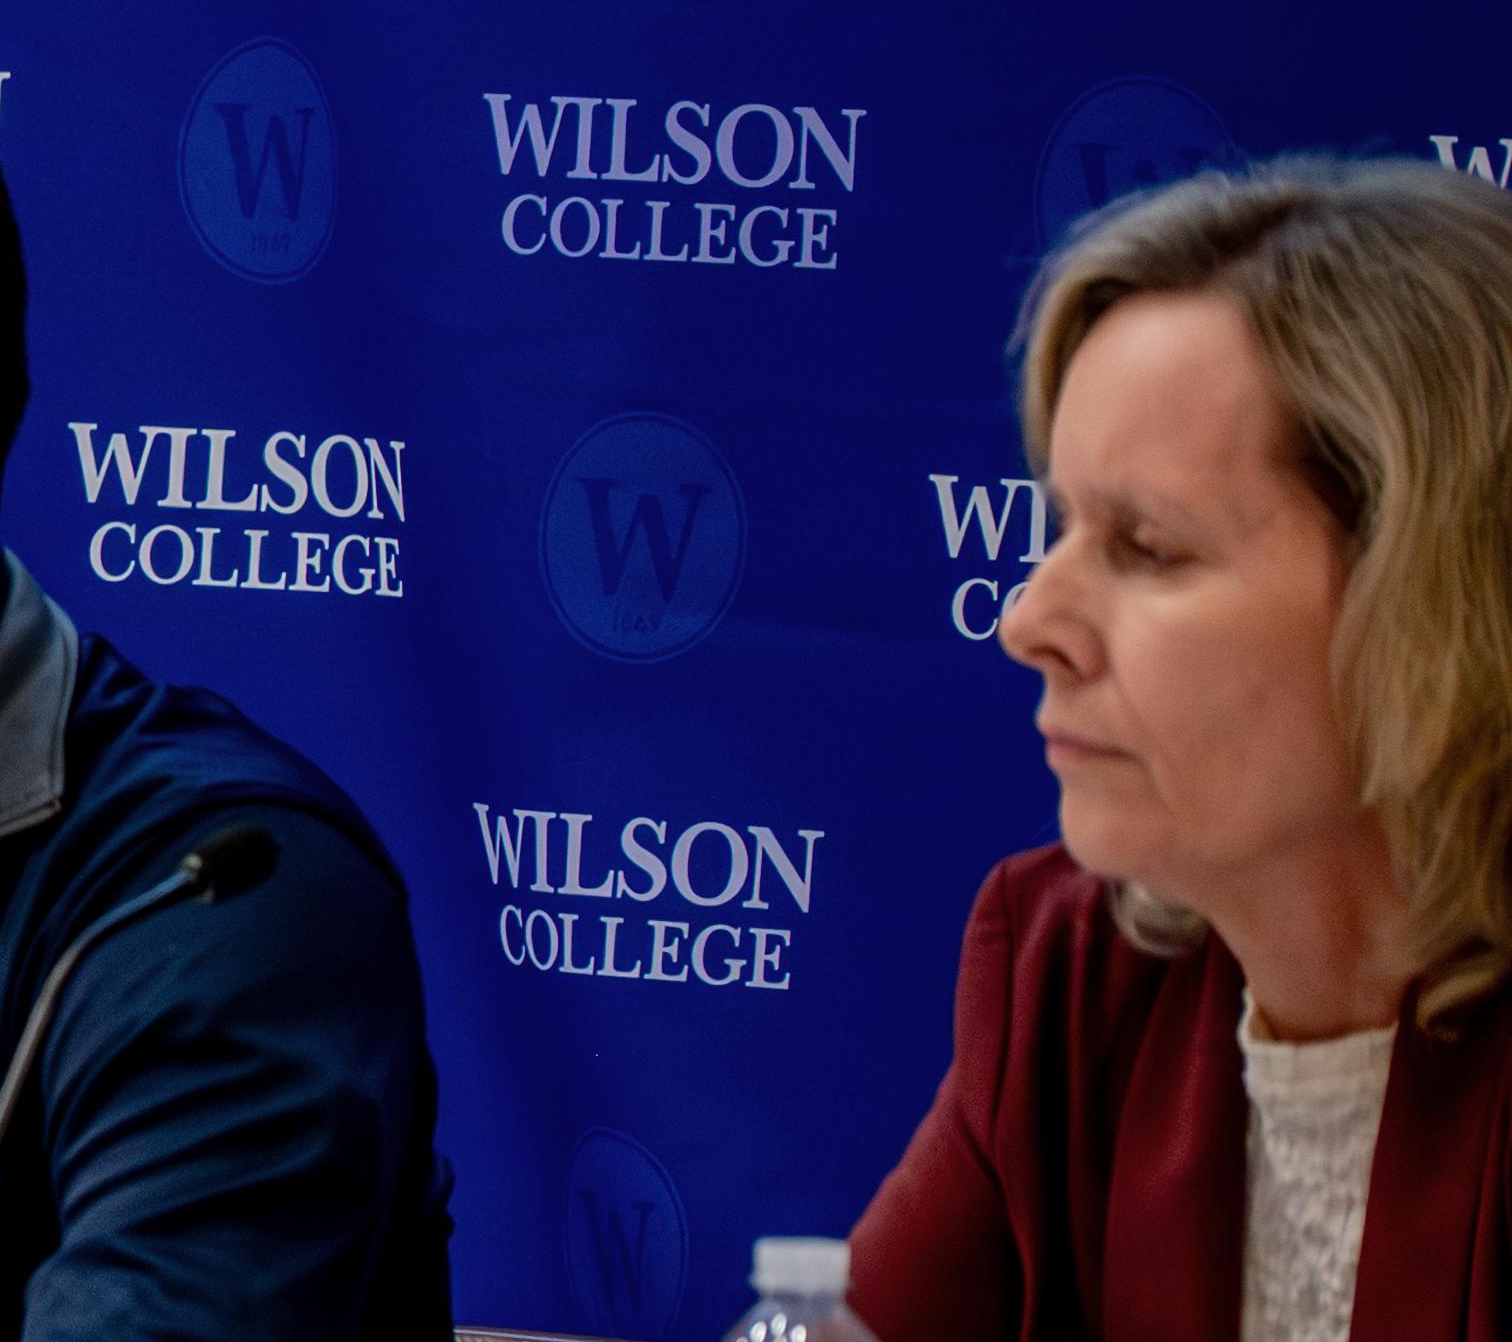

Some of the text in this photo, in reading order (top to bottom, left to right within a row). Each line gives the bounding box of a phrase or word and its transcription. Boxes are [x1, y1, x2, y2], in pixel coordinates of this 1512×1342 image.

[217, 104, 315, 222] W
[483, 93, 867, 191] WILSON
[502, 194, 837, 269] COLLEGE
[68, 422, 405, 521] WILSON
[89, 521, 403, 597] COLLEGE
[581, 478, 714, 604] W
[473, 803, 824, 913] WILSON
[500, 905, 791, 990] COLLEGE
